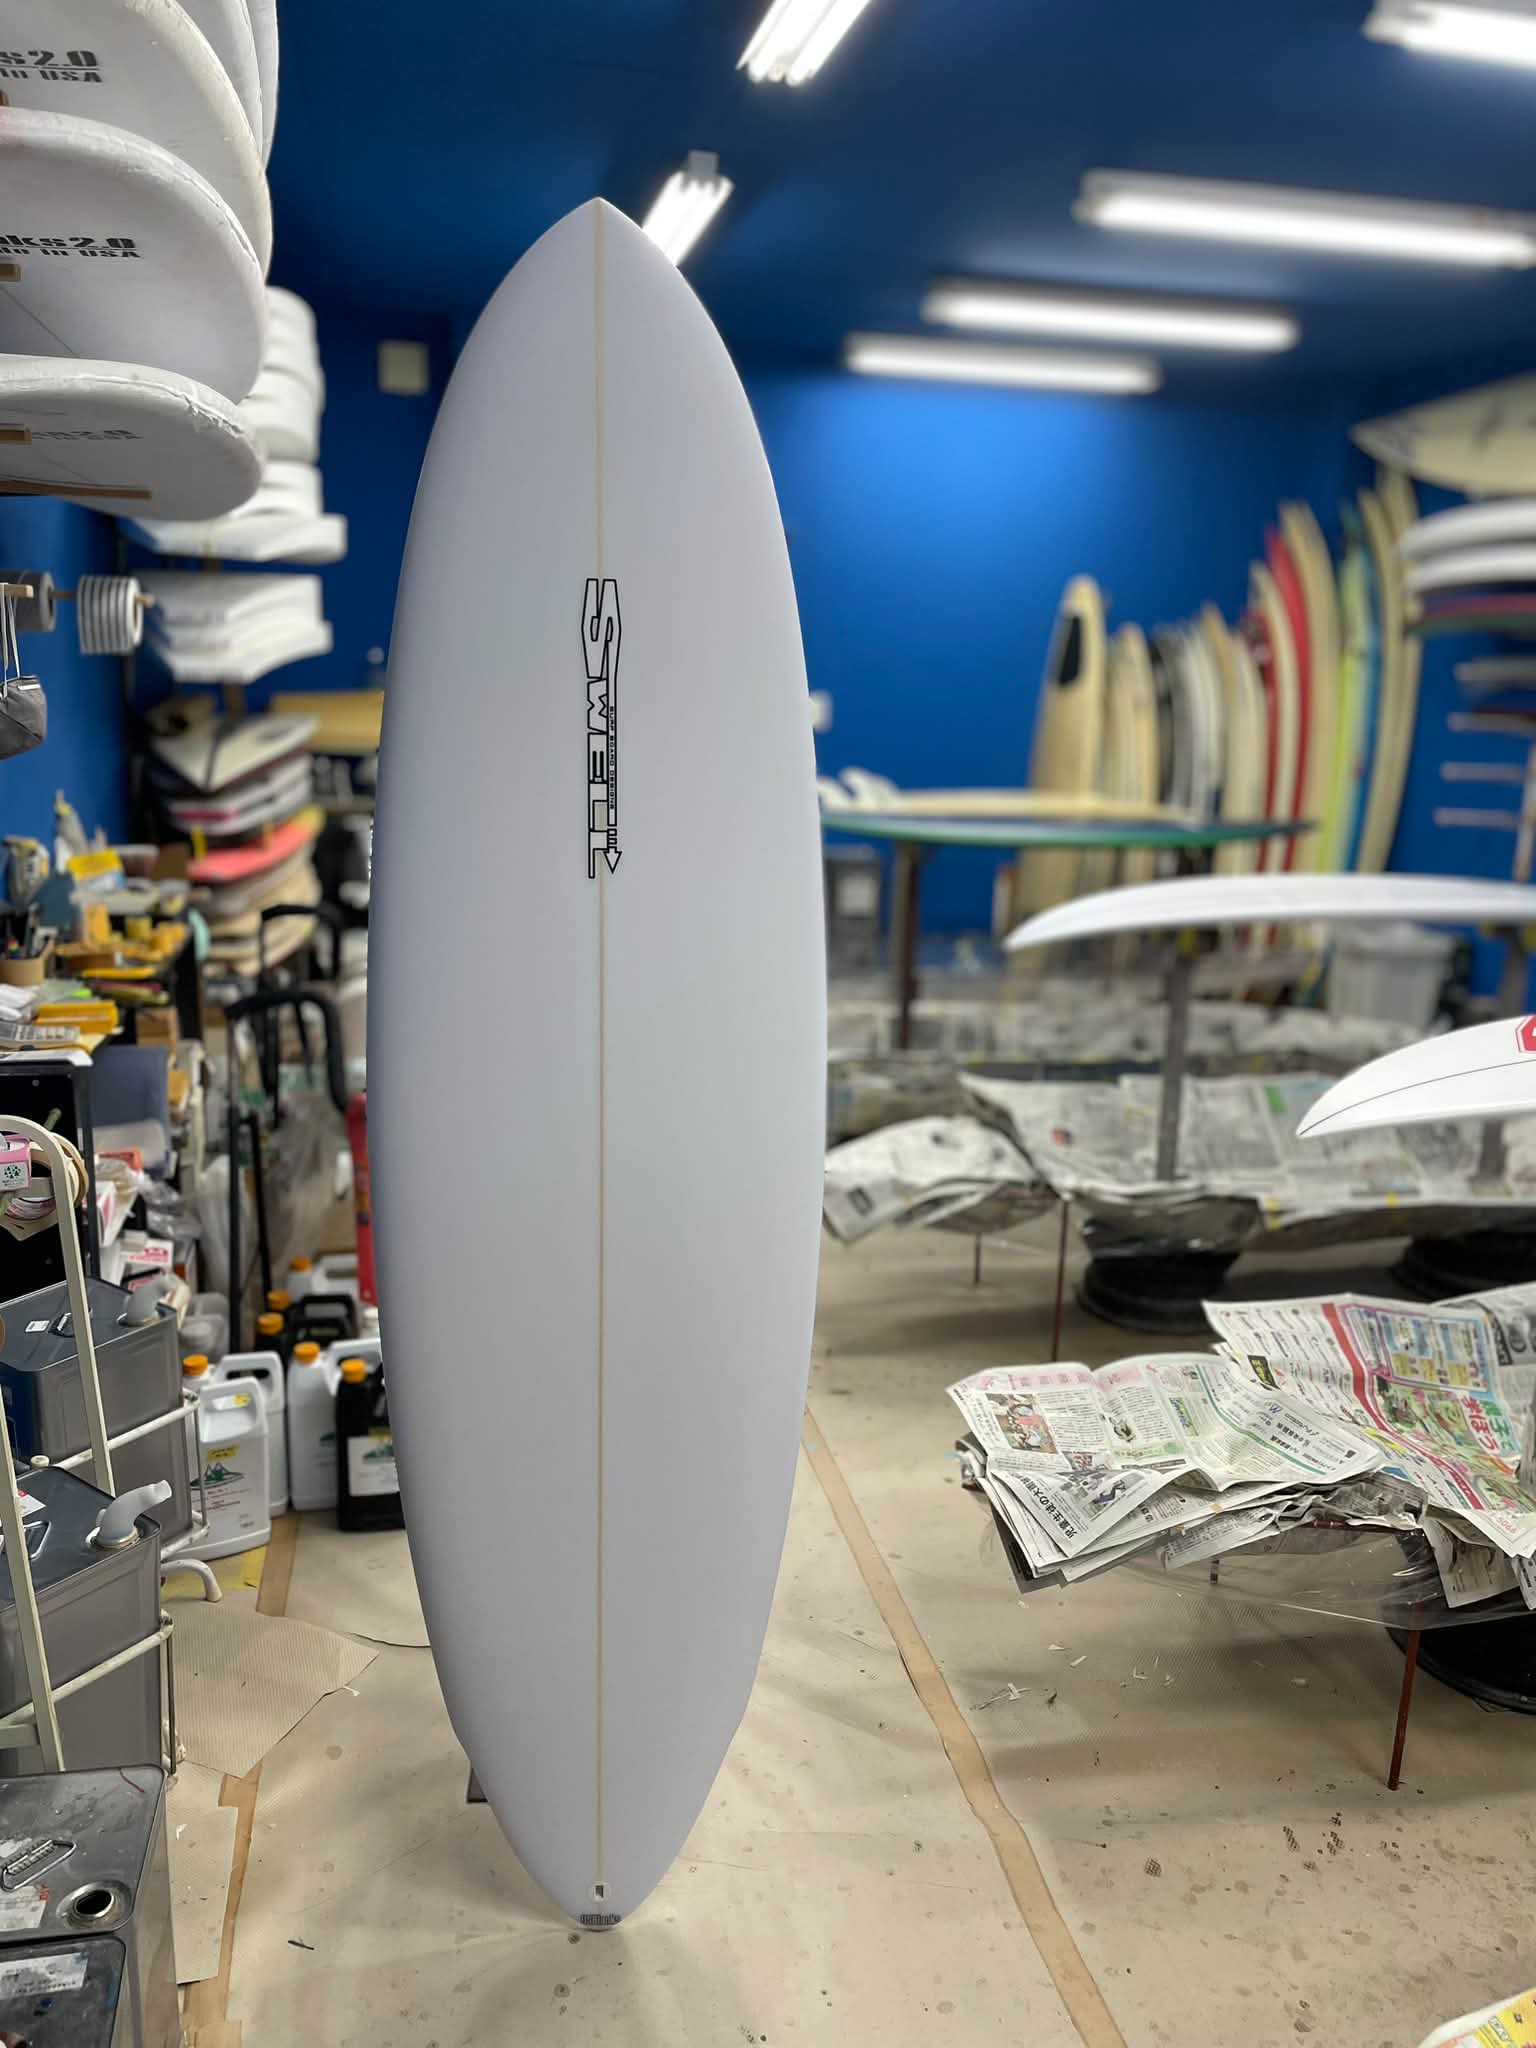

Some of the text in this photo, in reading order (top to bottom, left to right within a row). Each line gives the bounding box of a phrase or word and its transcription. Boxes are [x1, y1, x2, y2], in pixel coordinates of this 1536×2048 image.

[39, 70, 103, 83] USA
[79, 249, 141, 258] USA
[581, 578, 622, 879] SWELL
